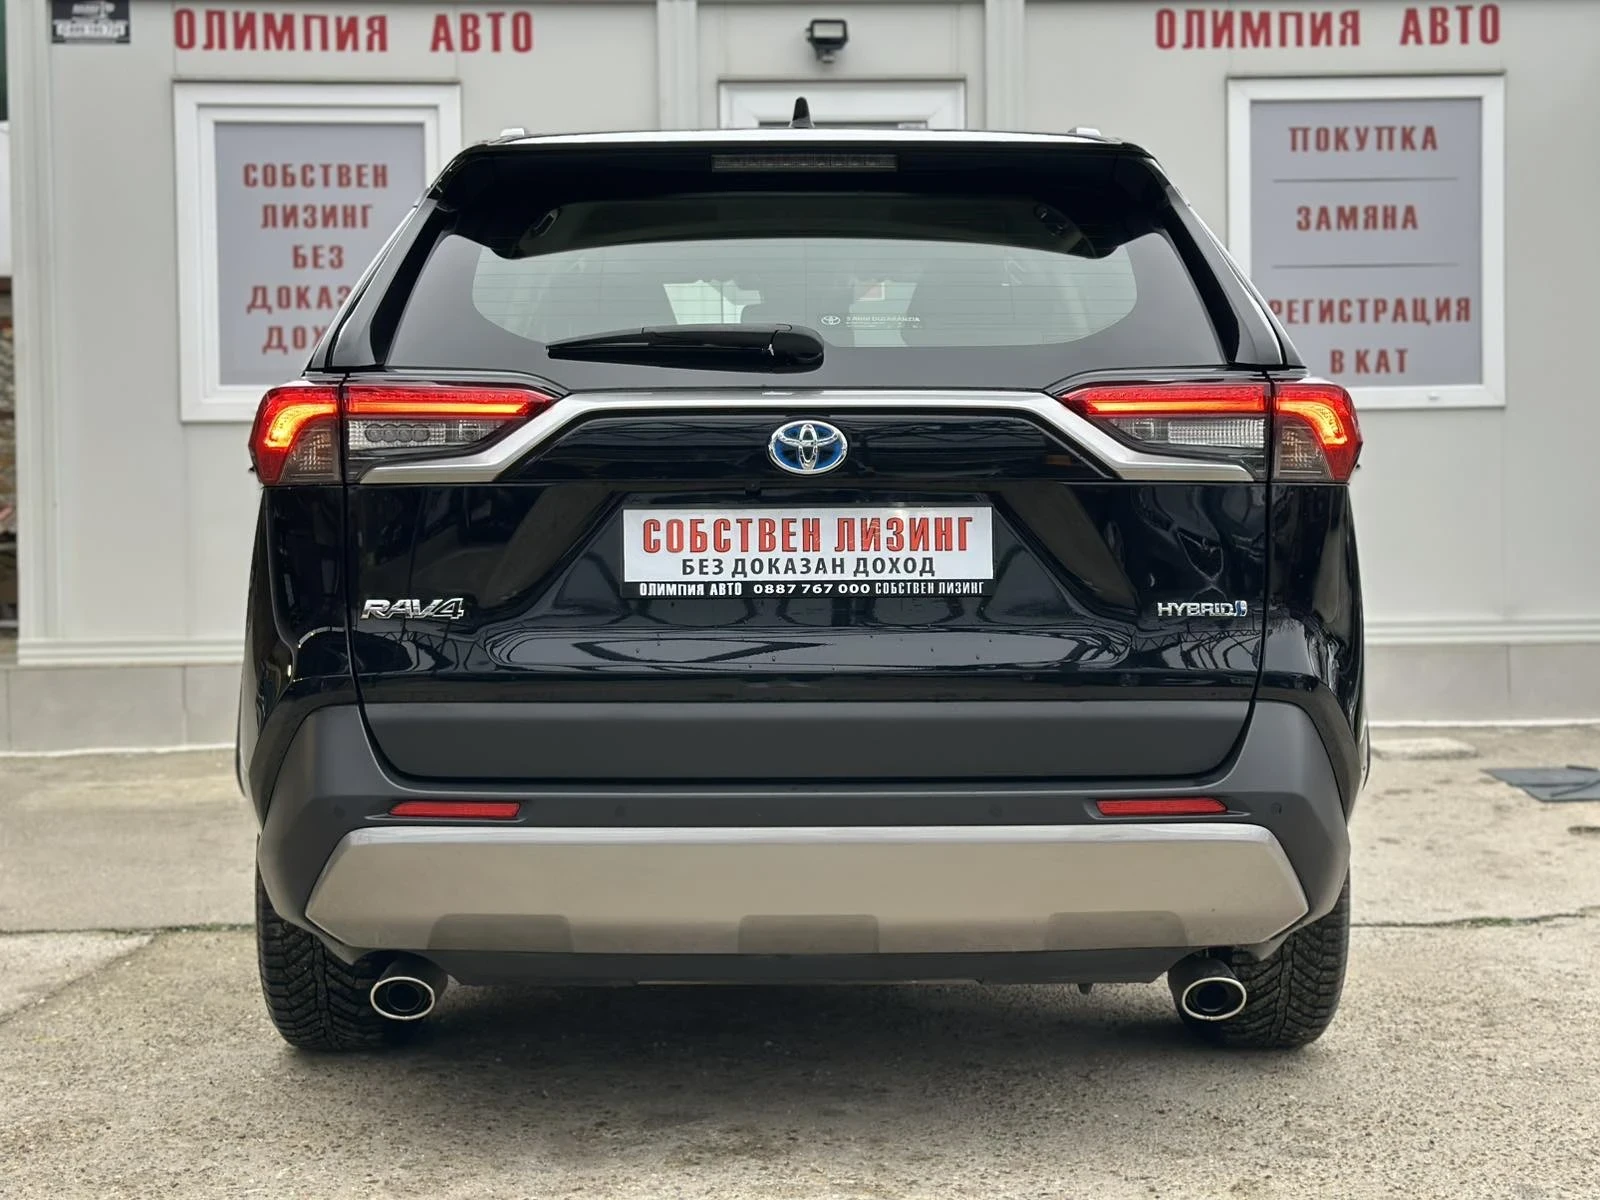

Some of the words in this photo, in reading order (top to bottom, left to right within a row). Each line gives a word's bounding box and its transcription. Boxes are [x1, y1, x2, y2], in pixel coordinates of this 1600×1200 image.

[173, 8, 388, 51] ОЛИМПИЯ
[430, 11, 533, 53] АВТО
[1155, 9, 1360, 49] ОЛИМПИЯ
[1400, 4, 1500, 46] АВТО
[1289, 126, 1438, 152] ПОКУПКА
[243, 163, 388, 188] СОБСТВЕН
[261, 204, 373, 229] ЛИЗИНГ
[1296, 205, 1418, 231] ЗАМЯНА
[292, 245, 344, 269] БЕЗ
[1330, 349, 1344, 374] В
[1355, 348, 1408, 374] КАТ
[643, 518, 820, 553] СОБСТВЕН
[834, 517, 973, 552] ЛИЗИНГ
[682, 558, 724, 575] БЕЗ
[731, 557, 845, 578] ДОКАЗАН
[853, 557, 935, 577] ДОХОД
[639, 583, 705, 596] ОЛИМПИЯ
[709, 582, 742, 596] АВТО
[753, 584, 797, 594] 0887
[801, 584, 832, 594] 767
[838, 584, 870, 594] 000
[875, 582, 934, 594] СОБСТВЕН
[938, 582, 984, 594] ЛИЗИНГ
[360, 598, 464, 619] RAV4
[1157, 602, 1235, 616] HYBRID
